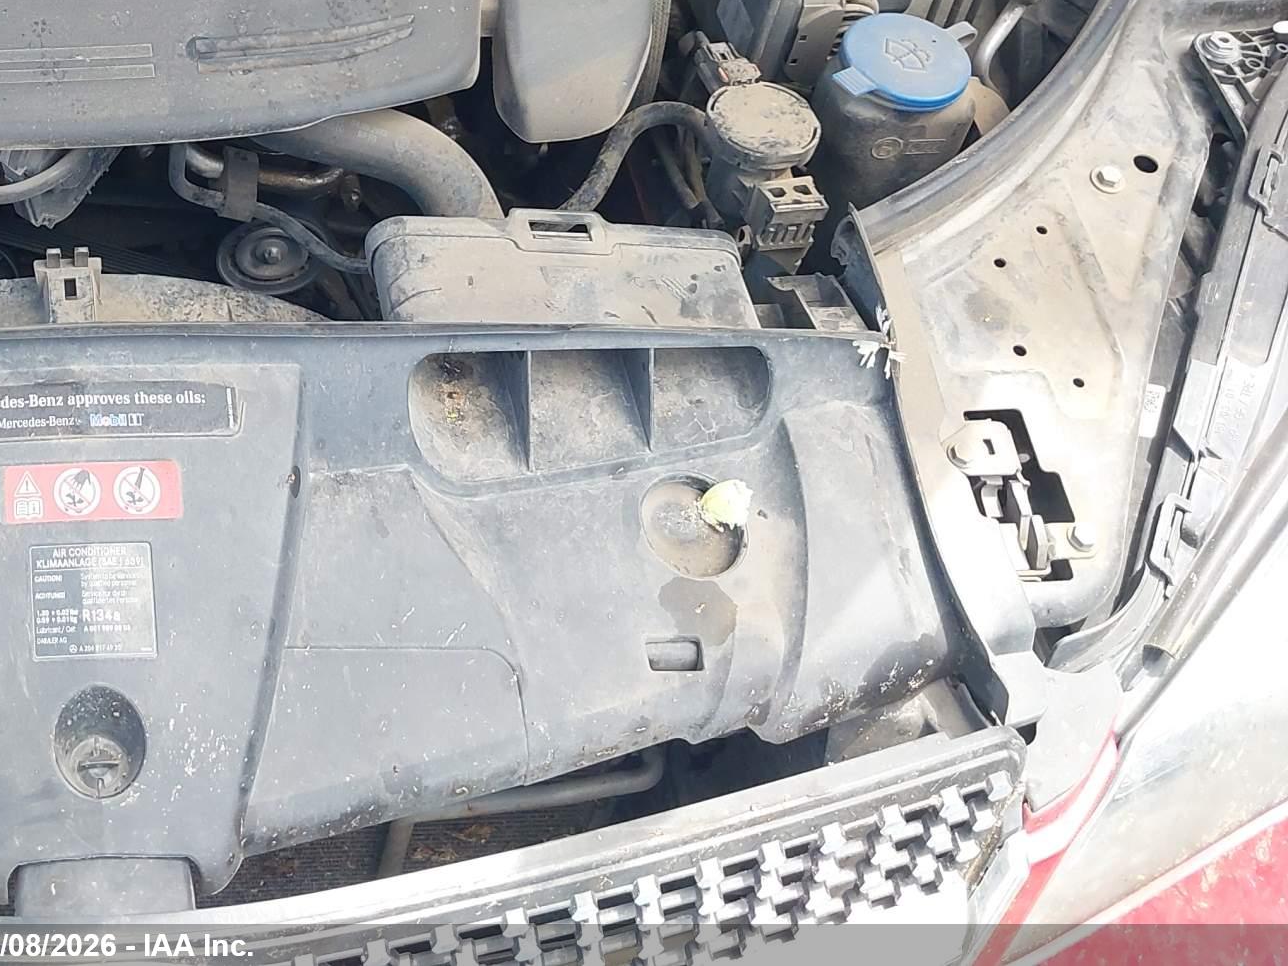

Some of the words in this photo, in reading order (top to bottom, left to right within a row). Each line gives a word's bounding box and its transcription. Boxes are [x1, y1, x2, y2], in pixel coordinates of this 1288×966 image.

[67, 392, 131, 408] approves
[134, 390, 172, 405] these
[175, 389, 207, 404] oils:
[52, 548, 67, 558] AIR
[68, 546, 127, 558] CONDITIONER
[35, 558, 96, 569] KLIMAANLAGE
[82, 609, 121, 622] R134a
